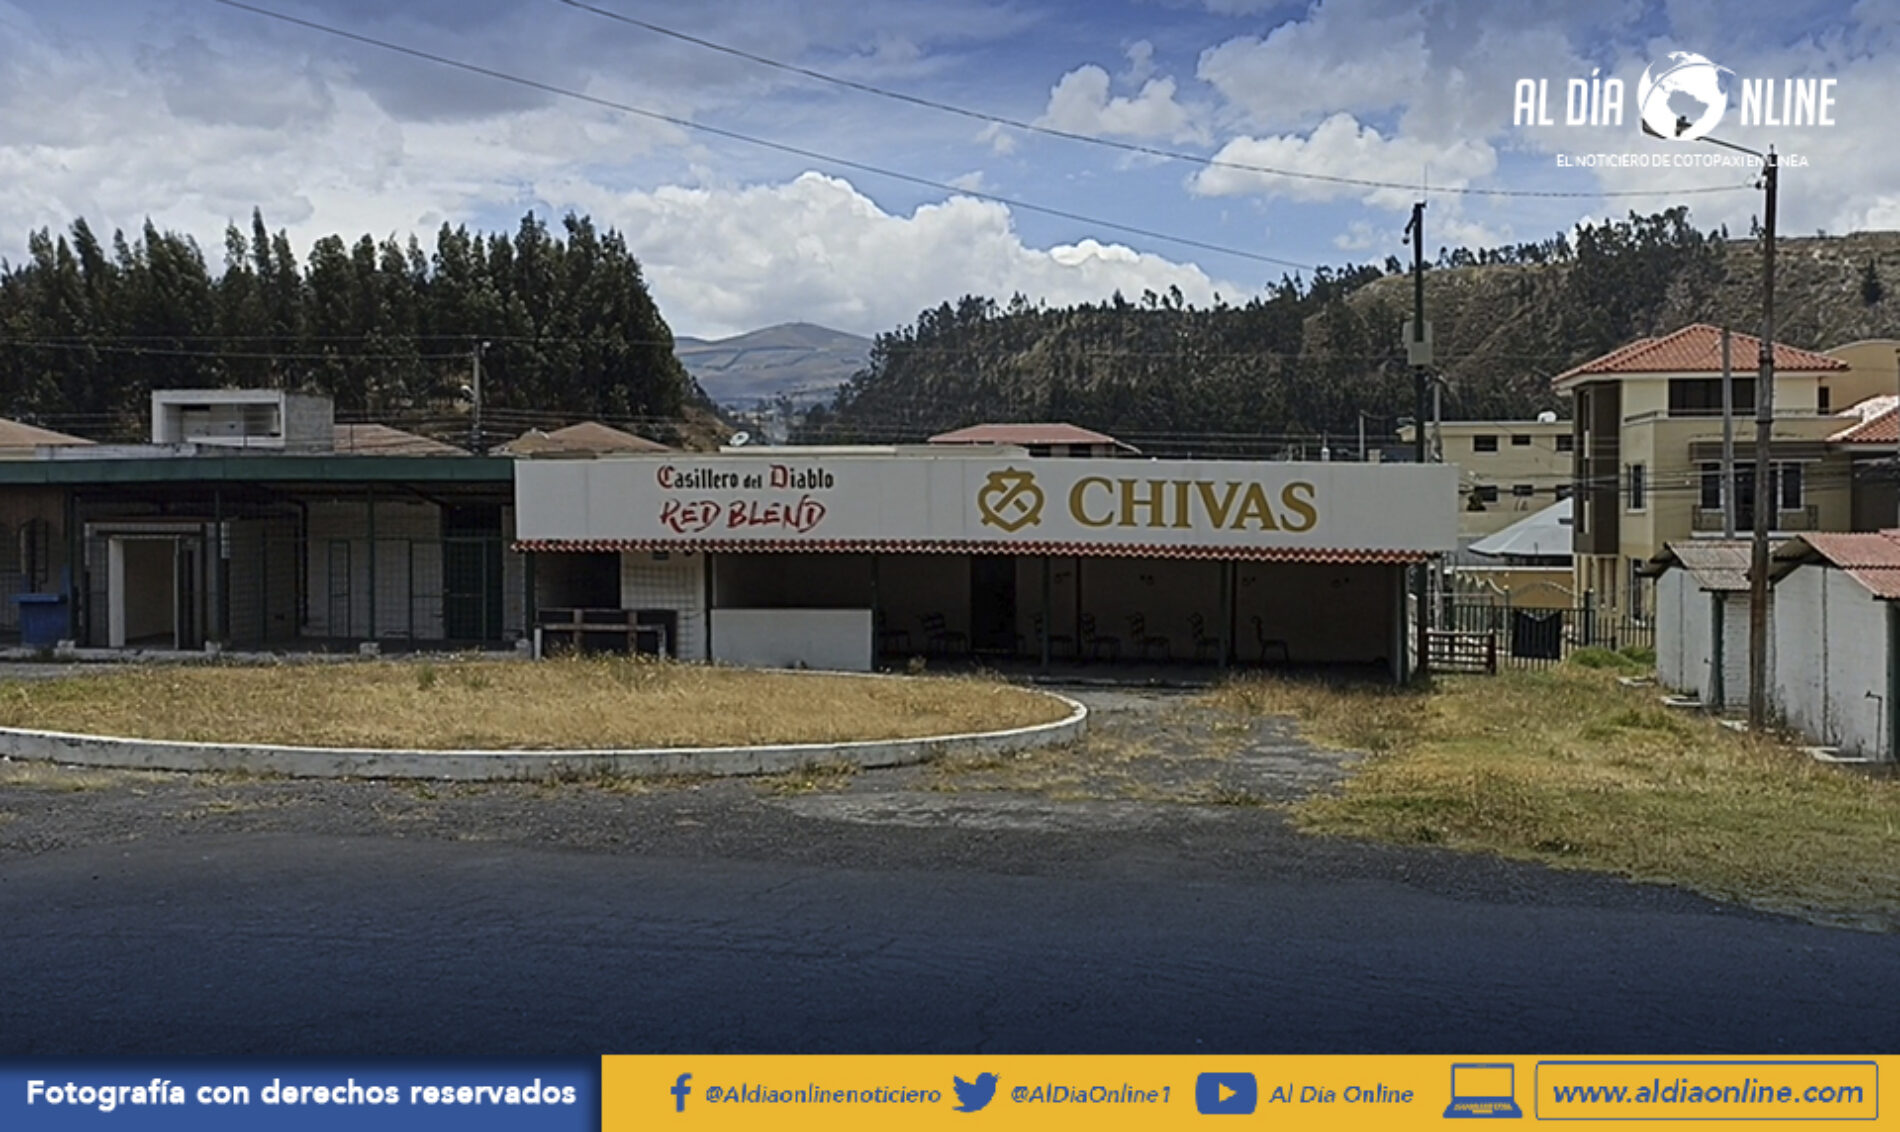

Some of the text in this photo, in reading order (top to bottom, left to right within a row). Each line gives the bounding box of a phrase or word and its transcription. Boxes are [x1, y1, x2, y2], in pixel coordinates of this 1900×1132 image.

[656, 463, 835, 490] Casillero del Diablo
[659, 494, 827, 534] RED BLEND
[1068, 476, 1318, 533] CHIVAS
